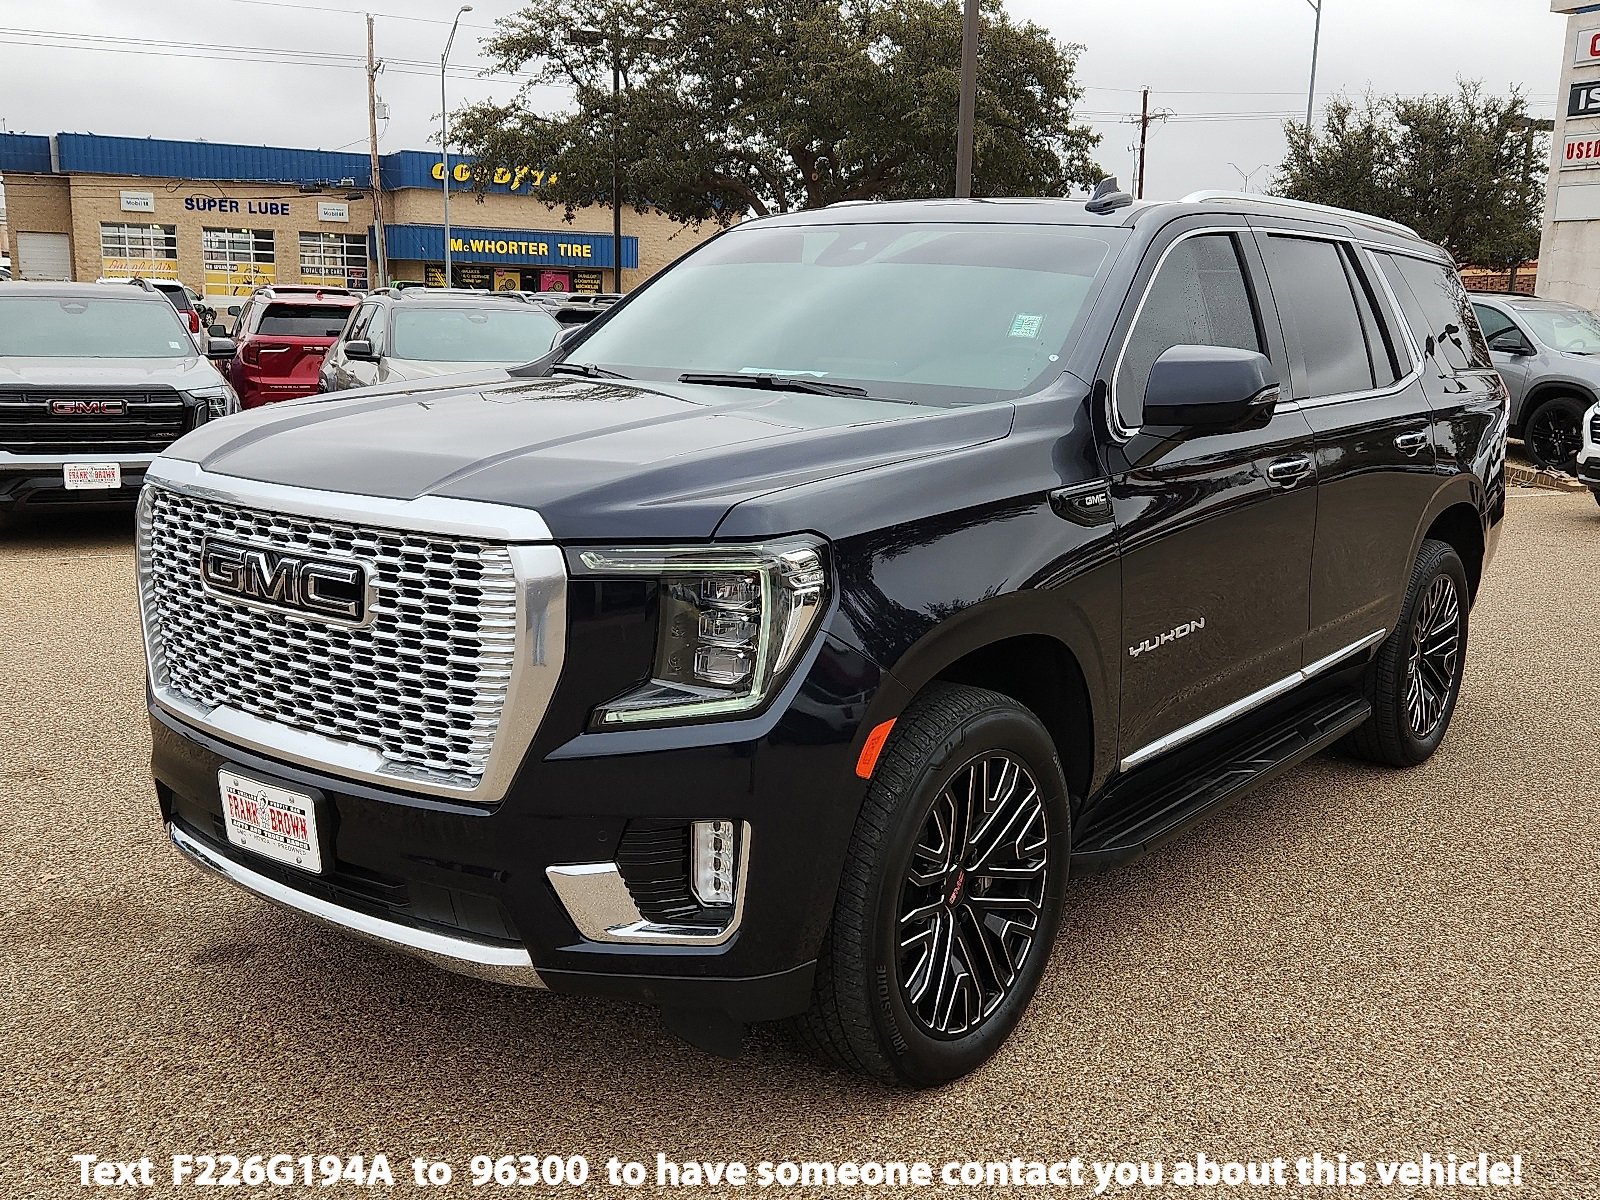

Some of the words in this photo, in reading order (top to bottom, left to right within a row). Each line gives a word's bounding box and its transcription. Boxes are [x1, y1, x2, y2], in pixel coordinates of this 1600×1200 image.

[1566, 139, 1600, 161] USED
[184, 197, 240, 213] SUPER
[247, 201, 290, 216] LUBE
[557, 243, 592, 258] TIRE
[303, 267, 318, 275] TOTAL
[52, 400, 125, 415] GMC
[68, 471, 88, 479] FRANK
[94, 470, 116, 479] BROWN
[1085, 493, 1107, 506] GMC
[203, 541, 360, 617] GMC
[1128, 616, 1206, 657] YUKON
[227, 794, 260, 827] FRANK
[269, 808, 309, 842] BROWN
[949, 871, 965, 905] GMC
